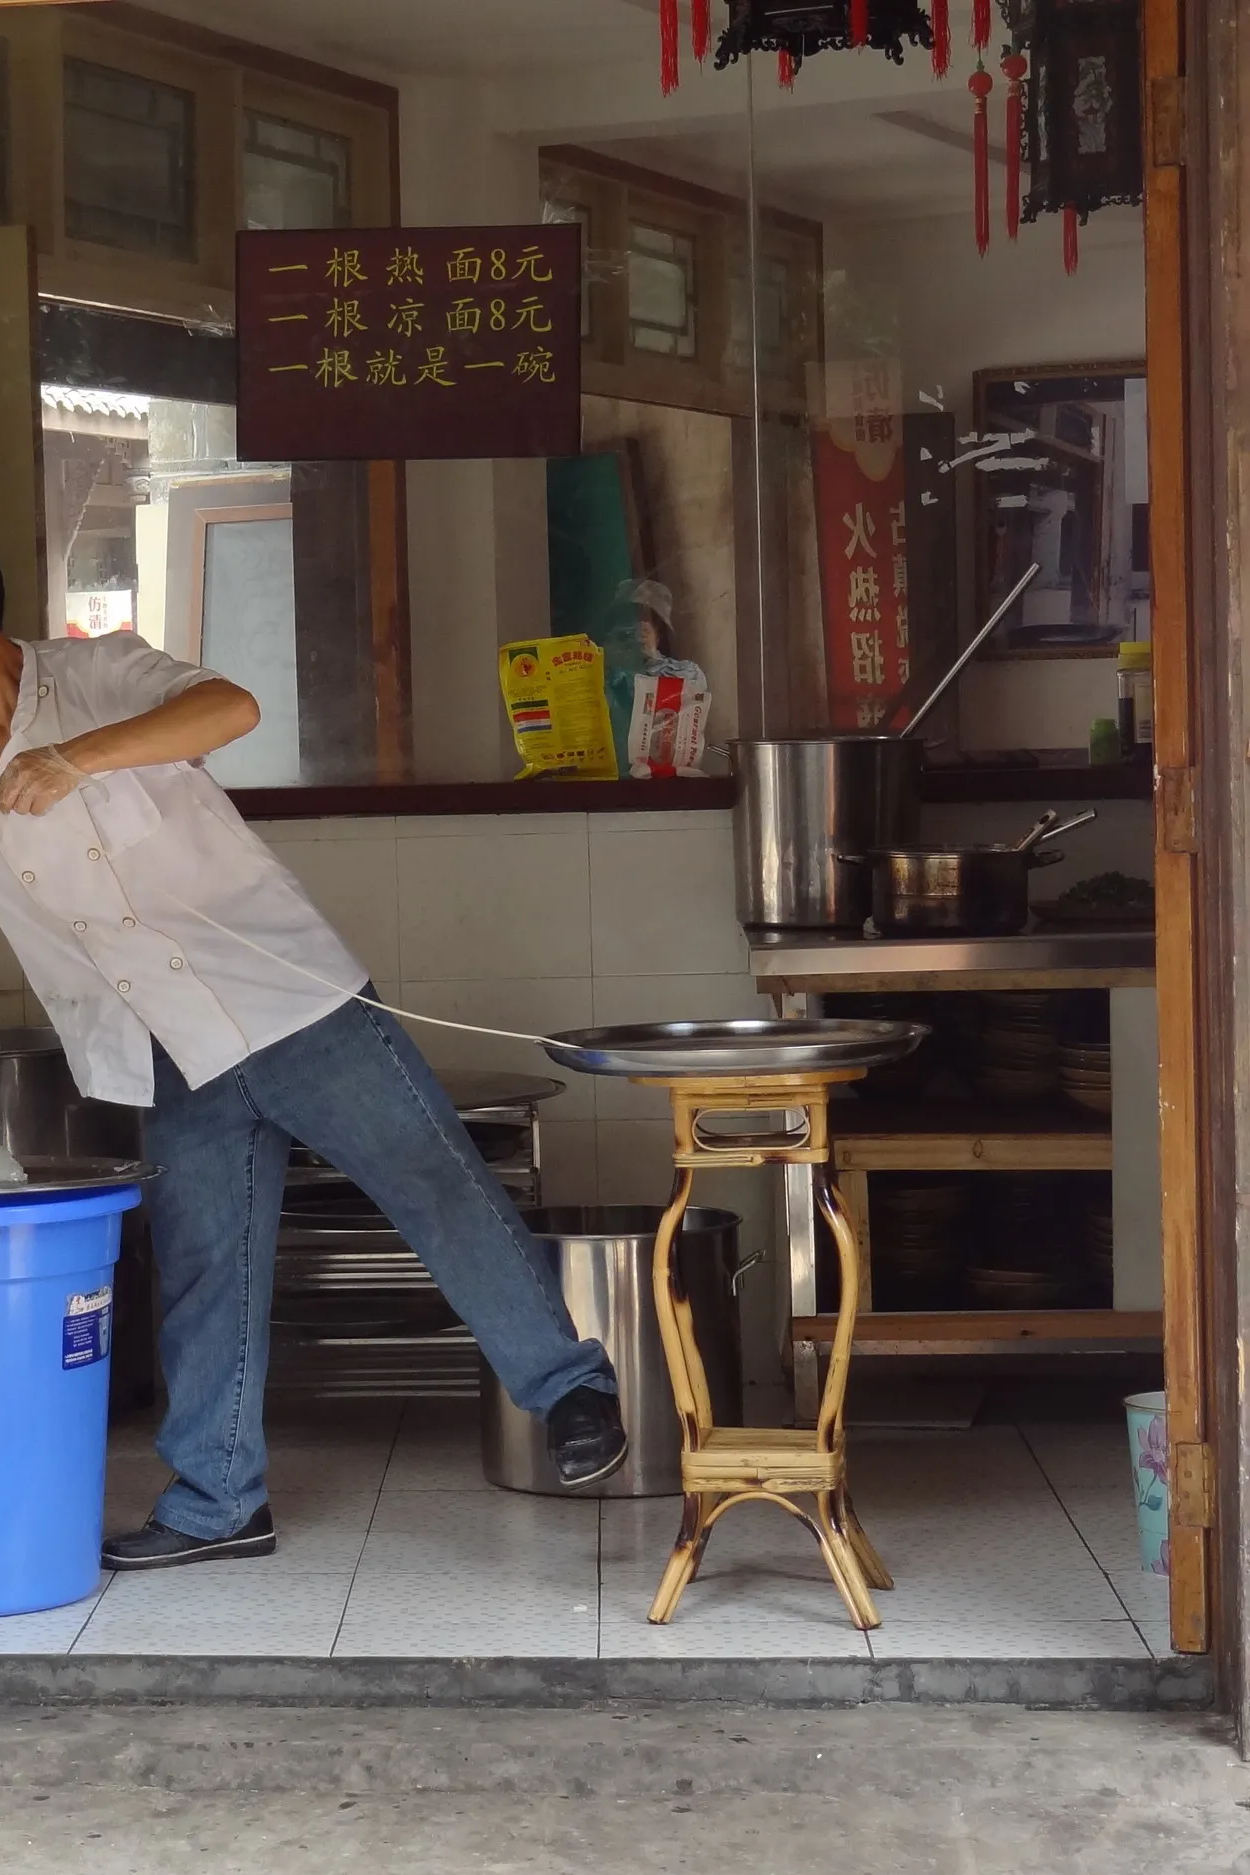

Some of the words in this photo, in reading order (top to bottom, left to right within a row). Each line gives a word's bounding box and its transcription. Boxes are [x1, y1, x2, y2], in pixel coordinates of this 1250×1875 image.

[268, 246, 553, 289] 一根热面8元
[268, 296, 553, 339] 一根凉面8元
[268, 346, 557, 389] 一根就是一碗
